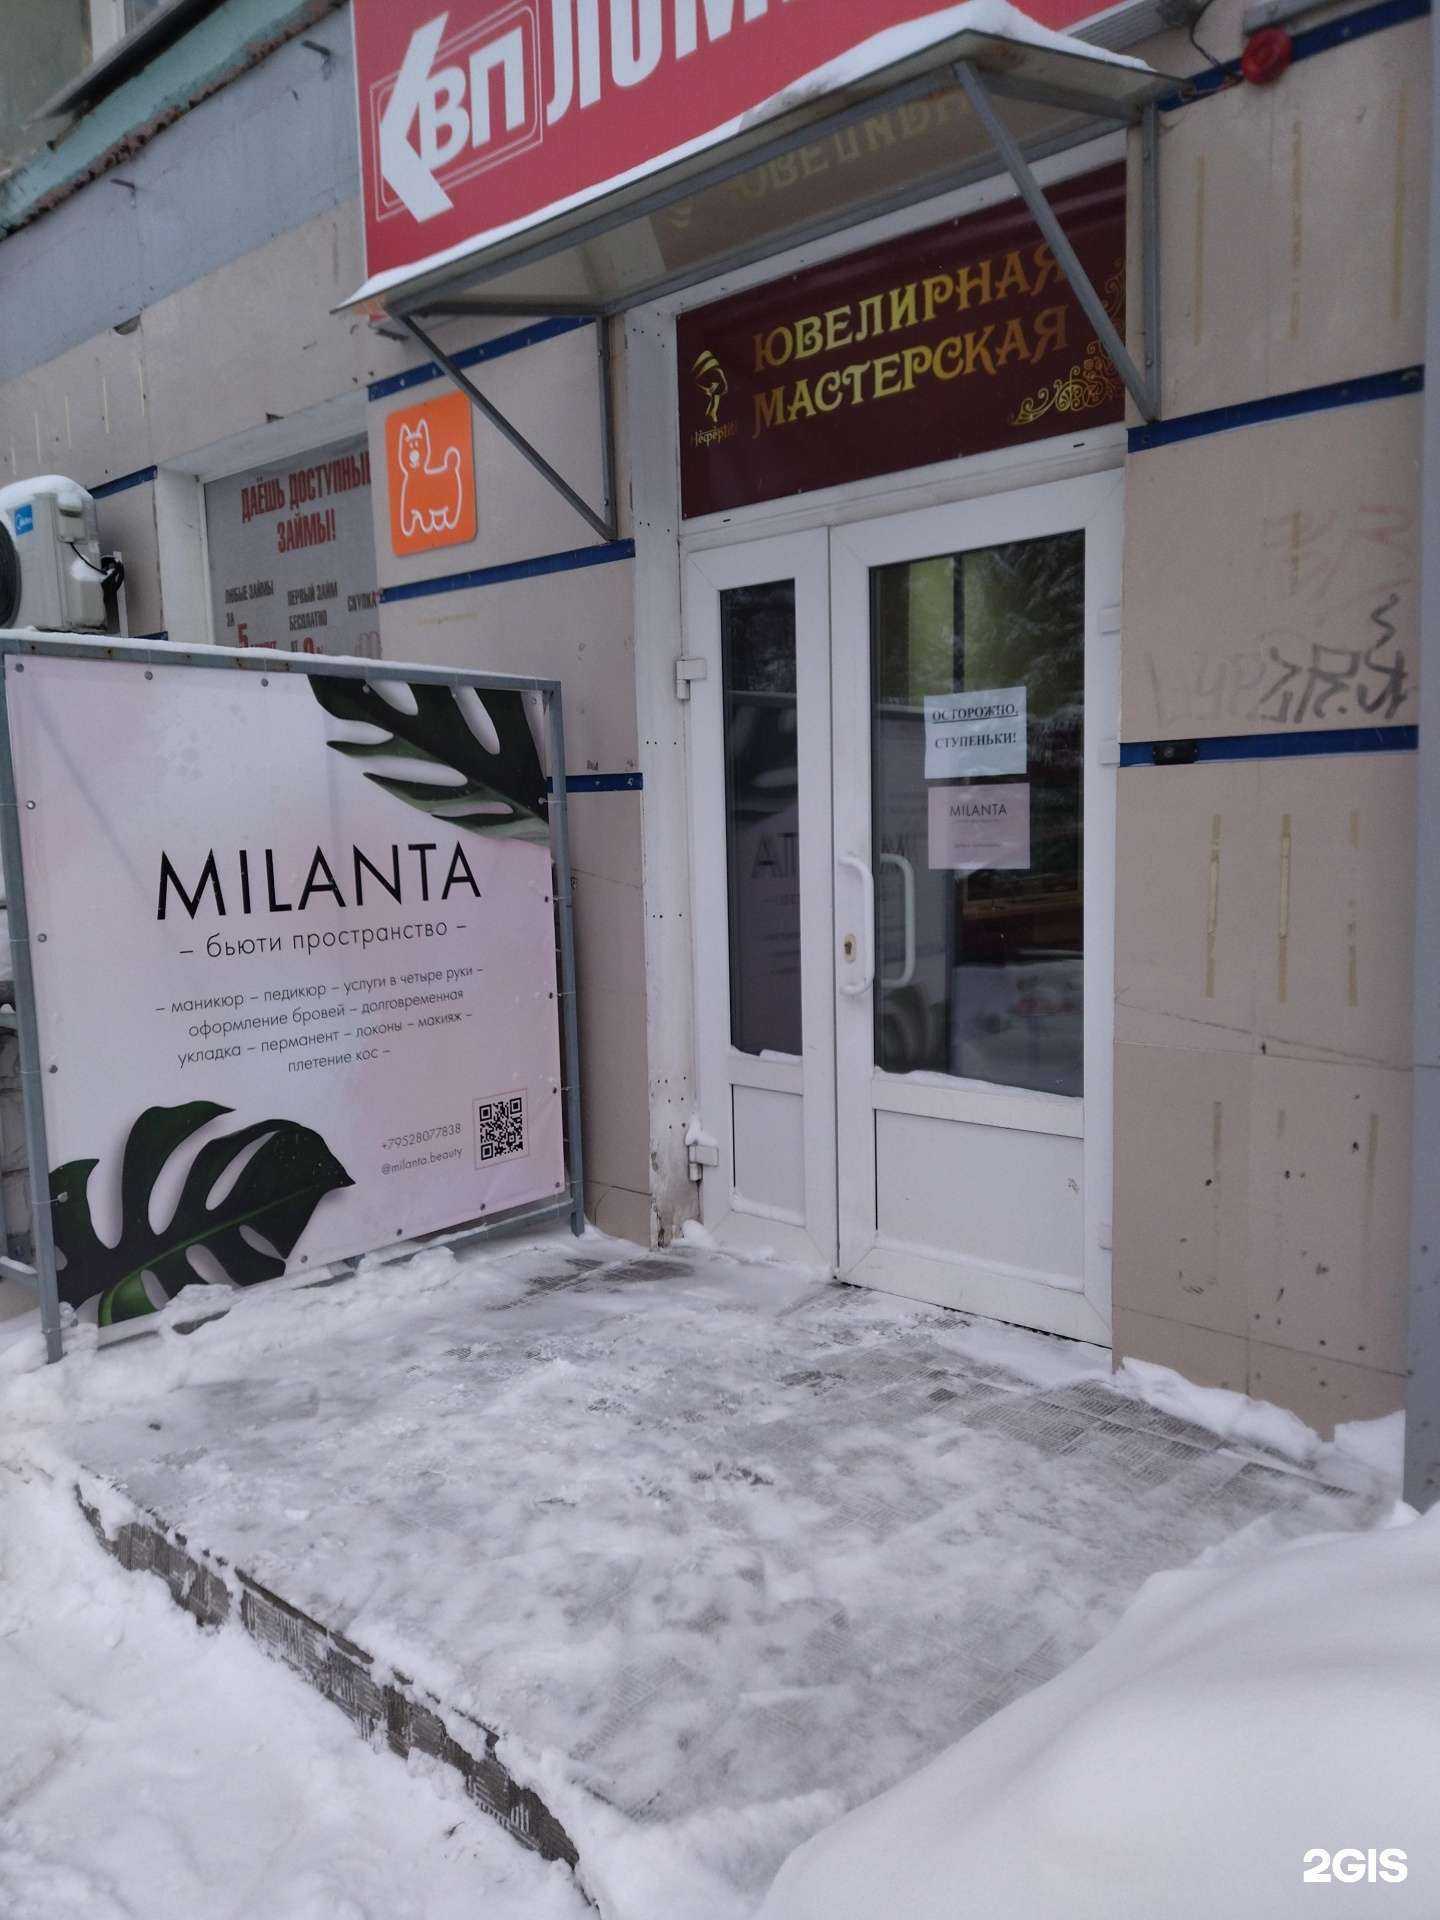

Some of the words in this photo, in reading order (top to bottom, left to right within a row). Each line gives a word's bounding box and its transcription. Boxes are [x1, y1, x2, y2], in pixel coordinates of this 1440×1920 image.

[752, 243, 1068, 374] ЮВЕЛИРНАЯ
[752, 304, 1070, 439] МАСТЕРСКАЯ
[241, 474, 286, 524] ДАЁШЬ
[277, 508, 336, 553] ЗАЙМЫ!
[934, 732, 1017, 749] СТУПЕНЬКИ!
[950, 803, 1009, 818] MILANTA
[157, 840, 482, 920] MILANTA
[206, 932, 282, 958] бьюти
[293, 920, 448, 955] пространство
[171, 993, 244, 1013] маникюр
[263, 984, 327, 1002] педикюр
[344, 976, 386, 996] услуги
[389, 977, 397, 987] в
[400, 969, 443, 986] четыре
[446, 967, 473, 982] руки
[188, 1012, 288, 1040] оформление
[292, 1003, 345, 1027] бровей
[361, 989, 464, 1015] долговременная
[177, 1044, 241, 1069] укладка
[261, 1030, 339, 1053] перманент
[356, 1021, 402, 1038] локоны
[417, 1012, 462, 1028] макияж
[288, 1051, 352, 1072] плетение
[356, 1048, 379, 1062] кос
[381, 1147, 463, 1175] @milanta.beauty
